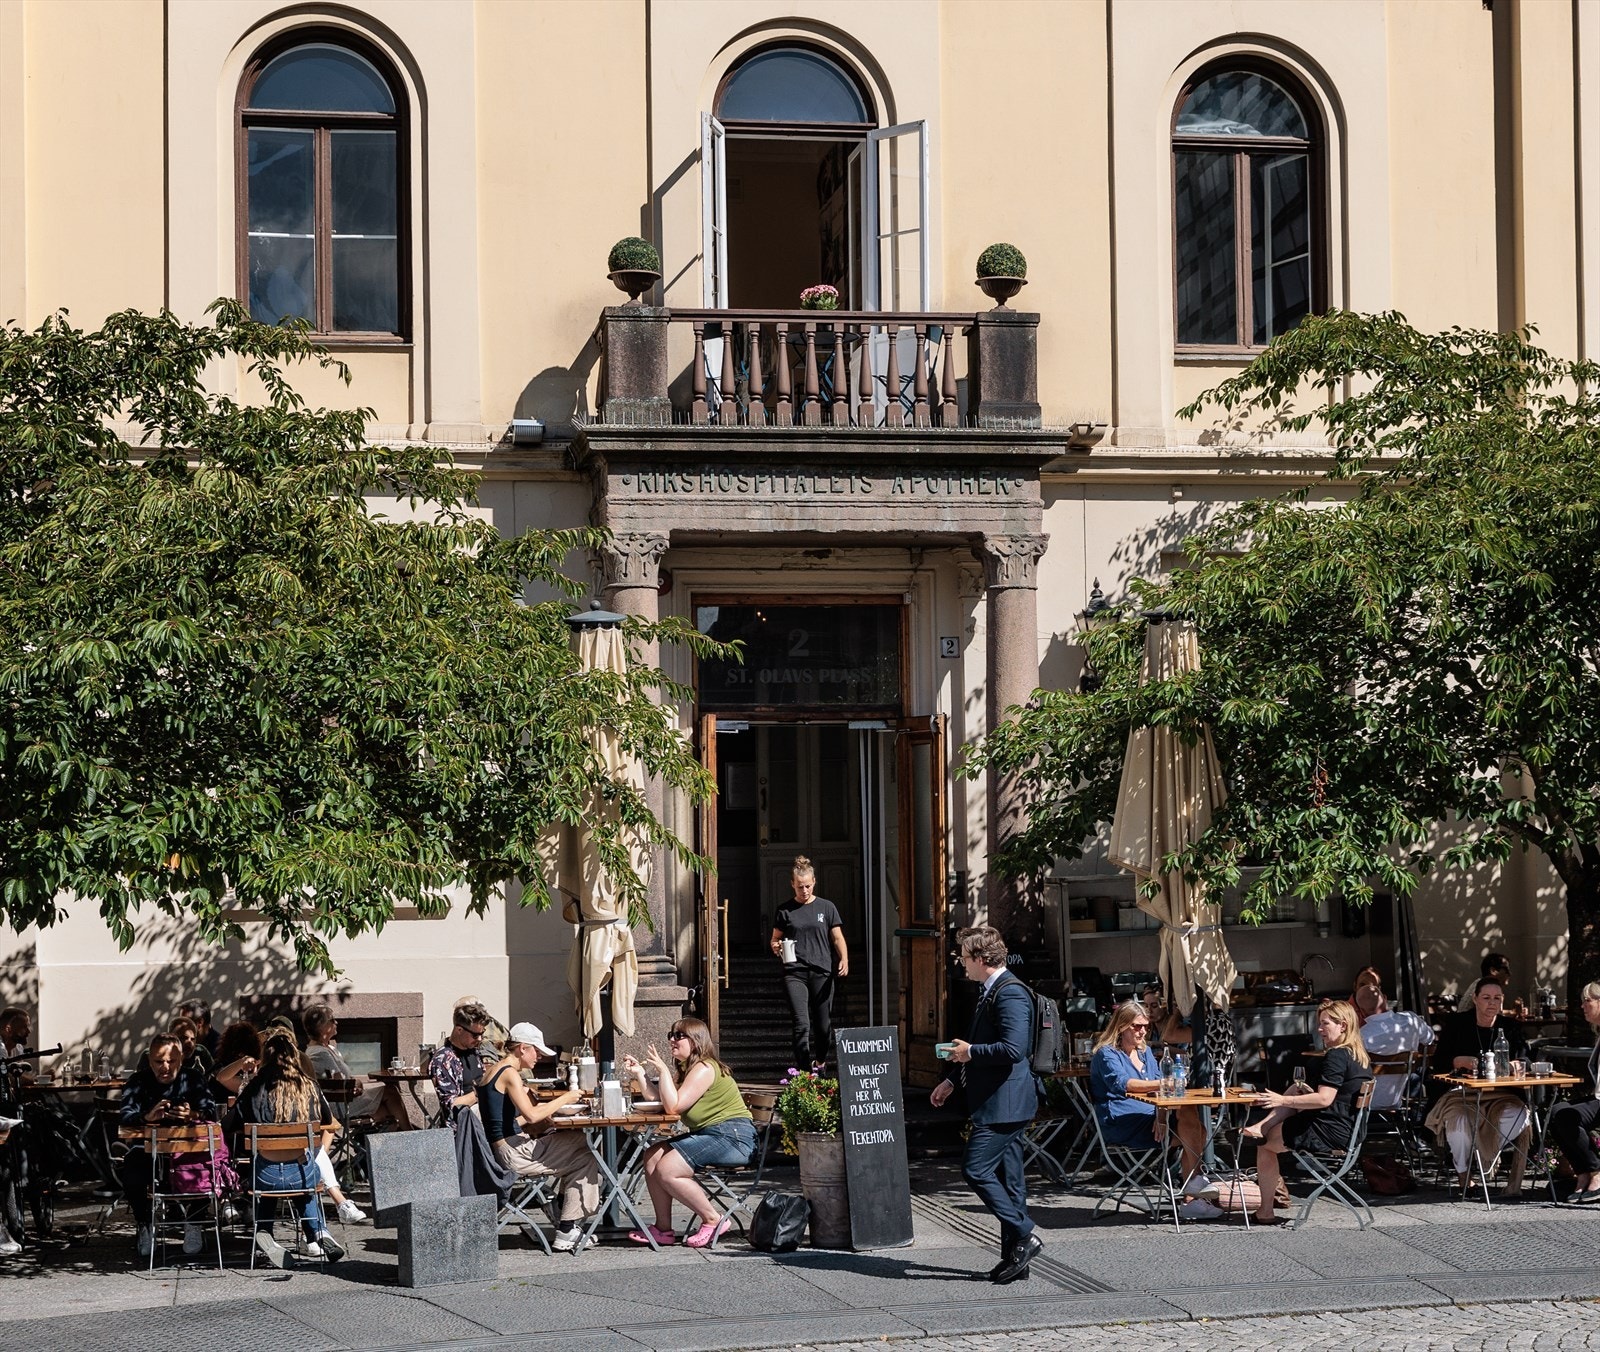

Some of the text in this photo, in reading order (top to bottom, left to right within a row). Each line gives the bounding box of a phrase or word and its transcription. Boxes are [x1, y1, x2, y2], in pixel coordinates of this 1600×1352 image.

[637, 468, 1010, 495] RIKSHOSPITALETS APOTHEK
[788, 629, 810, 657] 2
[946, 639, 955, 655] 2
[727, 668, 873, 685] ST. OLAVS PLASS
[842, 1036, 893, 1054] VELKOMMEN!
[849, 1063, 889, 1076] VENNLIGST
[860, 1078, 880, 1089] VENT
[856, 1090, 870, 1102] HER
[850, 1101, 896, 1117] PLASSERING
[849, 1129, 895, 1146] TEKEHTOPA
